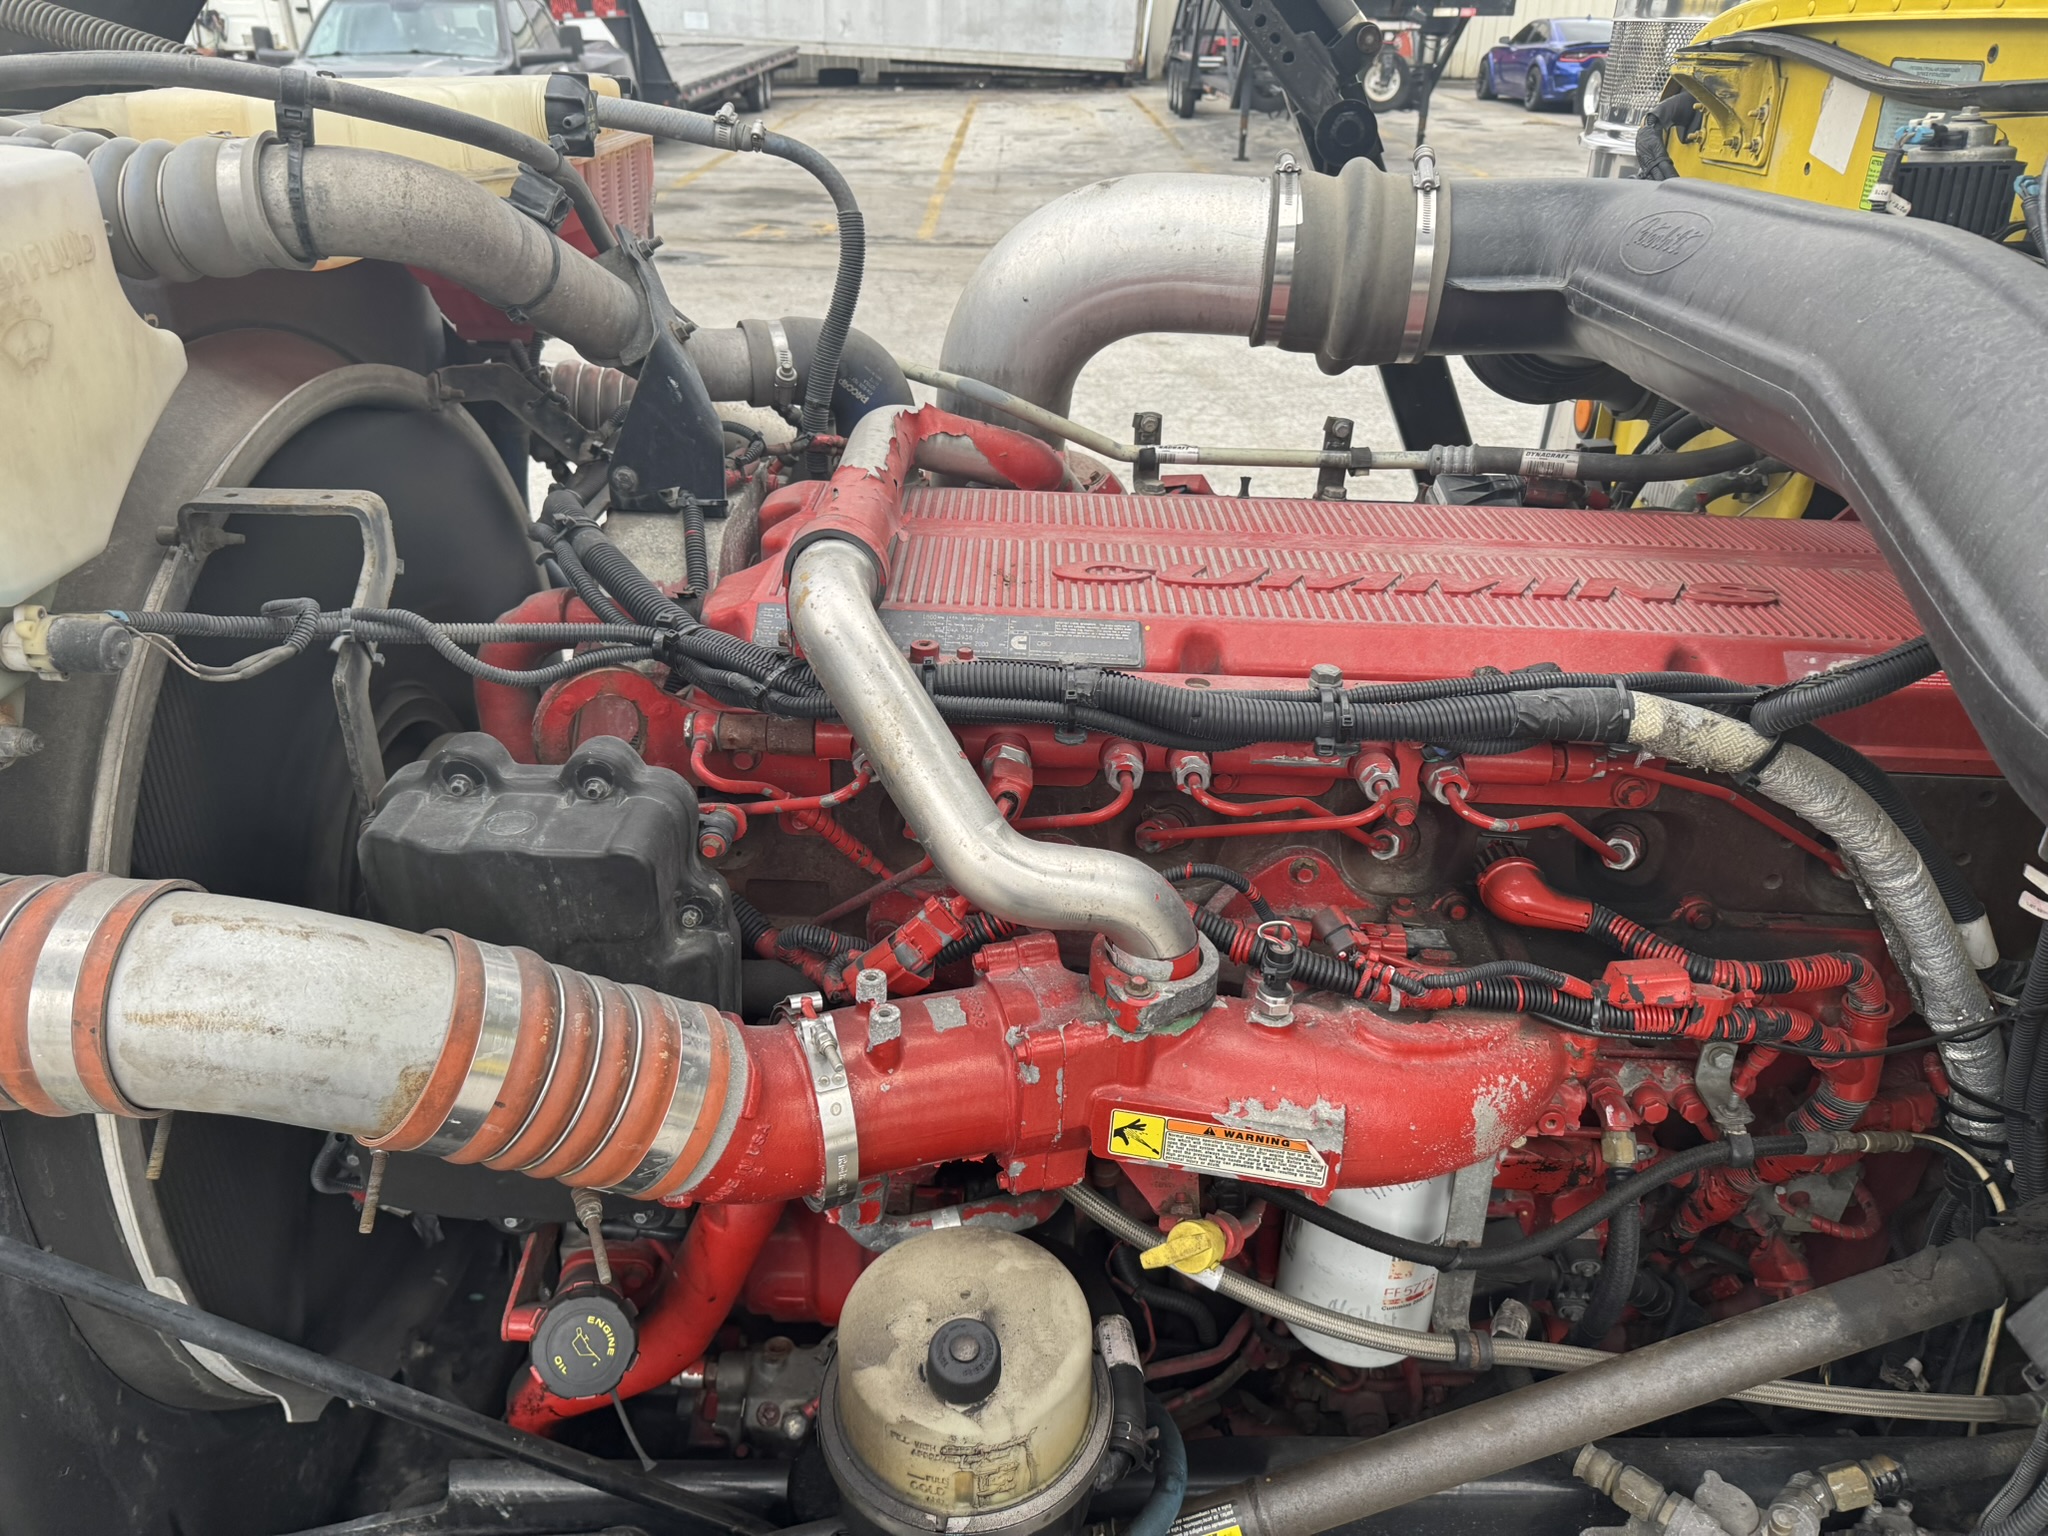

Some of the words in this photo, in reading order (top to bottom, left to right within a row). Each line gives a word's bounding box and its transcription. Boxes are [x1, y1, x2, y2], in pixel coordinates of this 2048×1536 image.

[21, 231, 97, 282] FLUID
[1526, 451, 1570, 460] DYNACRAFT
[1052, 562, 1780, 608] CUMMINS
[745, 1124, 772, 1156] USA
[1224, 1129, 1291, 1148] WARNING
[586, 1315, 616, 1357] ENGINE
[554, 1355, 567, 1375] OIL
